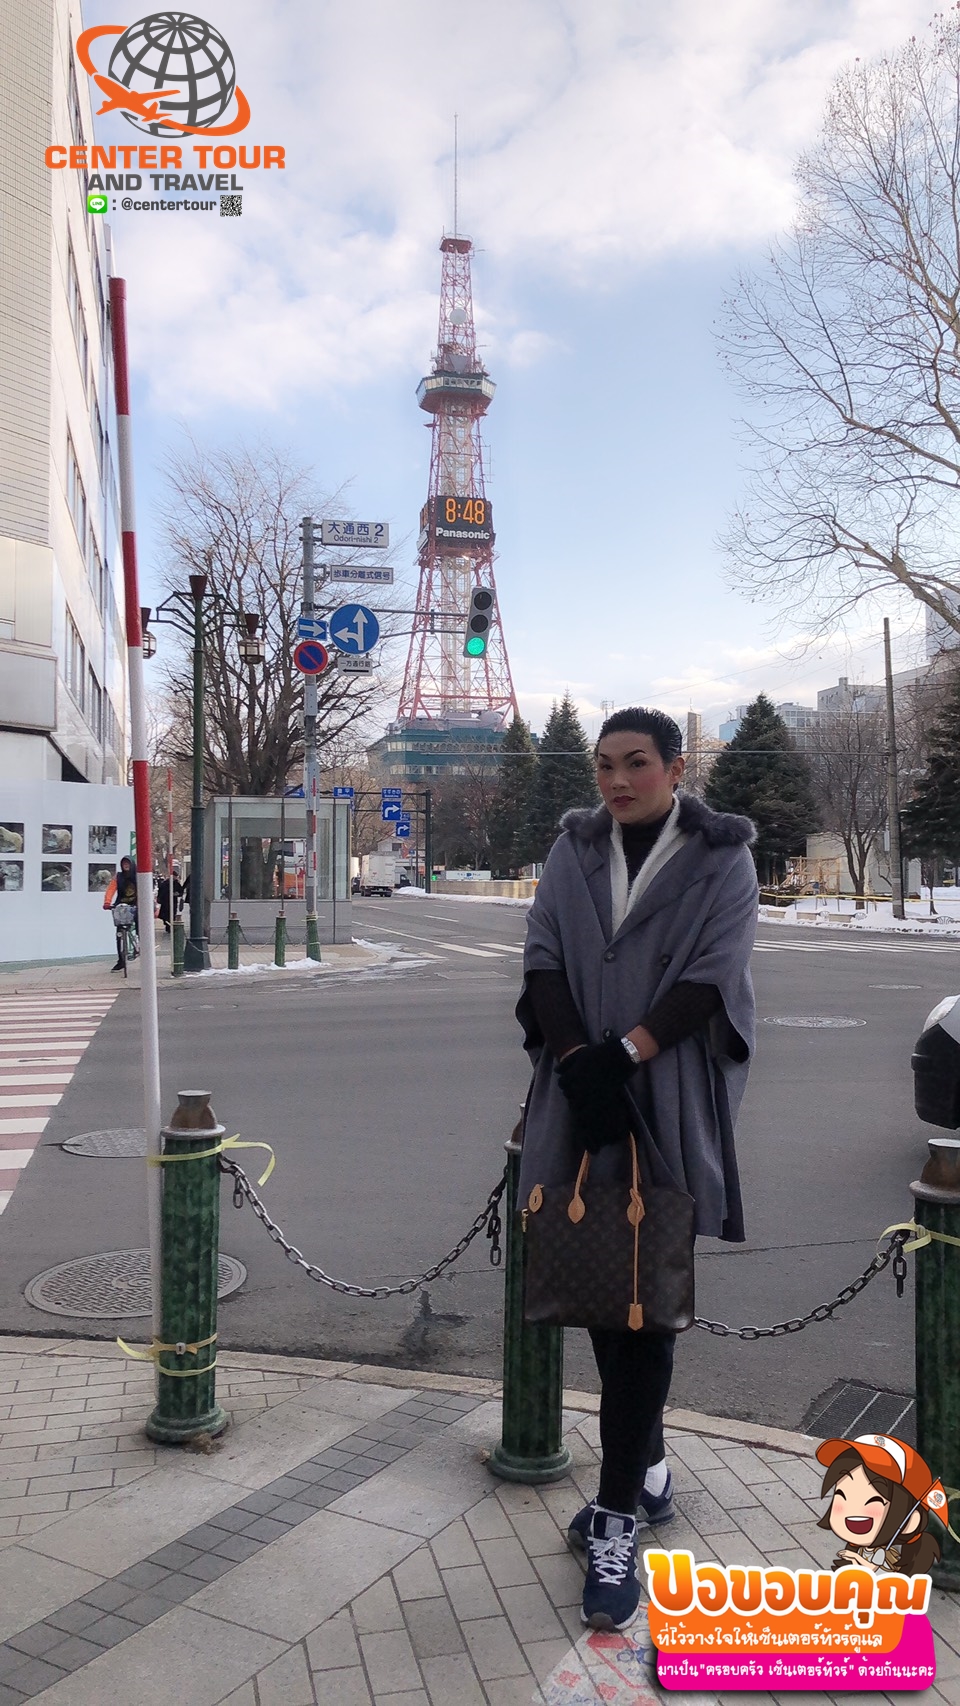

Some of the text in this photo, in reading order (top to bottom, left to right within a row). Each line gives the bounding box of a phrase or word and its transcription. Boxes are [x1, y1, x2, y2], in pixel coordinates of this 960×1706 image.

[445, 498, 485, 526] 8:48
[333, 534, 373, 543] Odori-nishi
[435, 527, 490, 540] Panasonic
[333, 569, 391, 581] 歩車分離式信号
